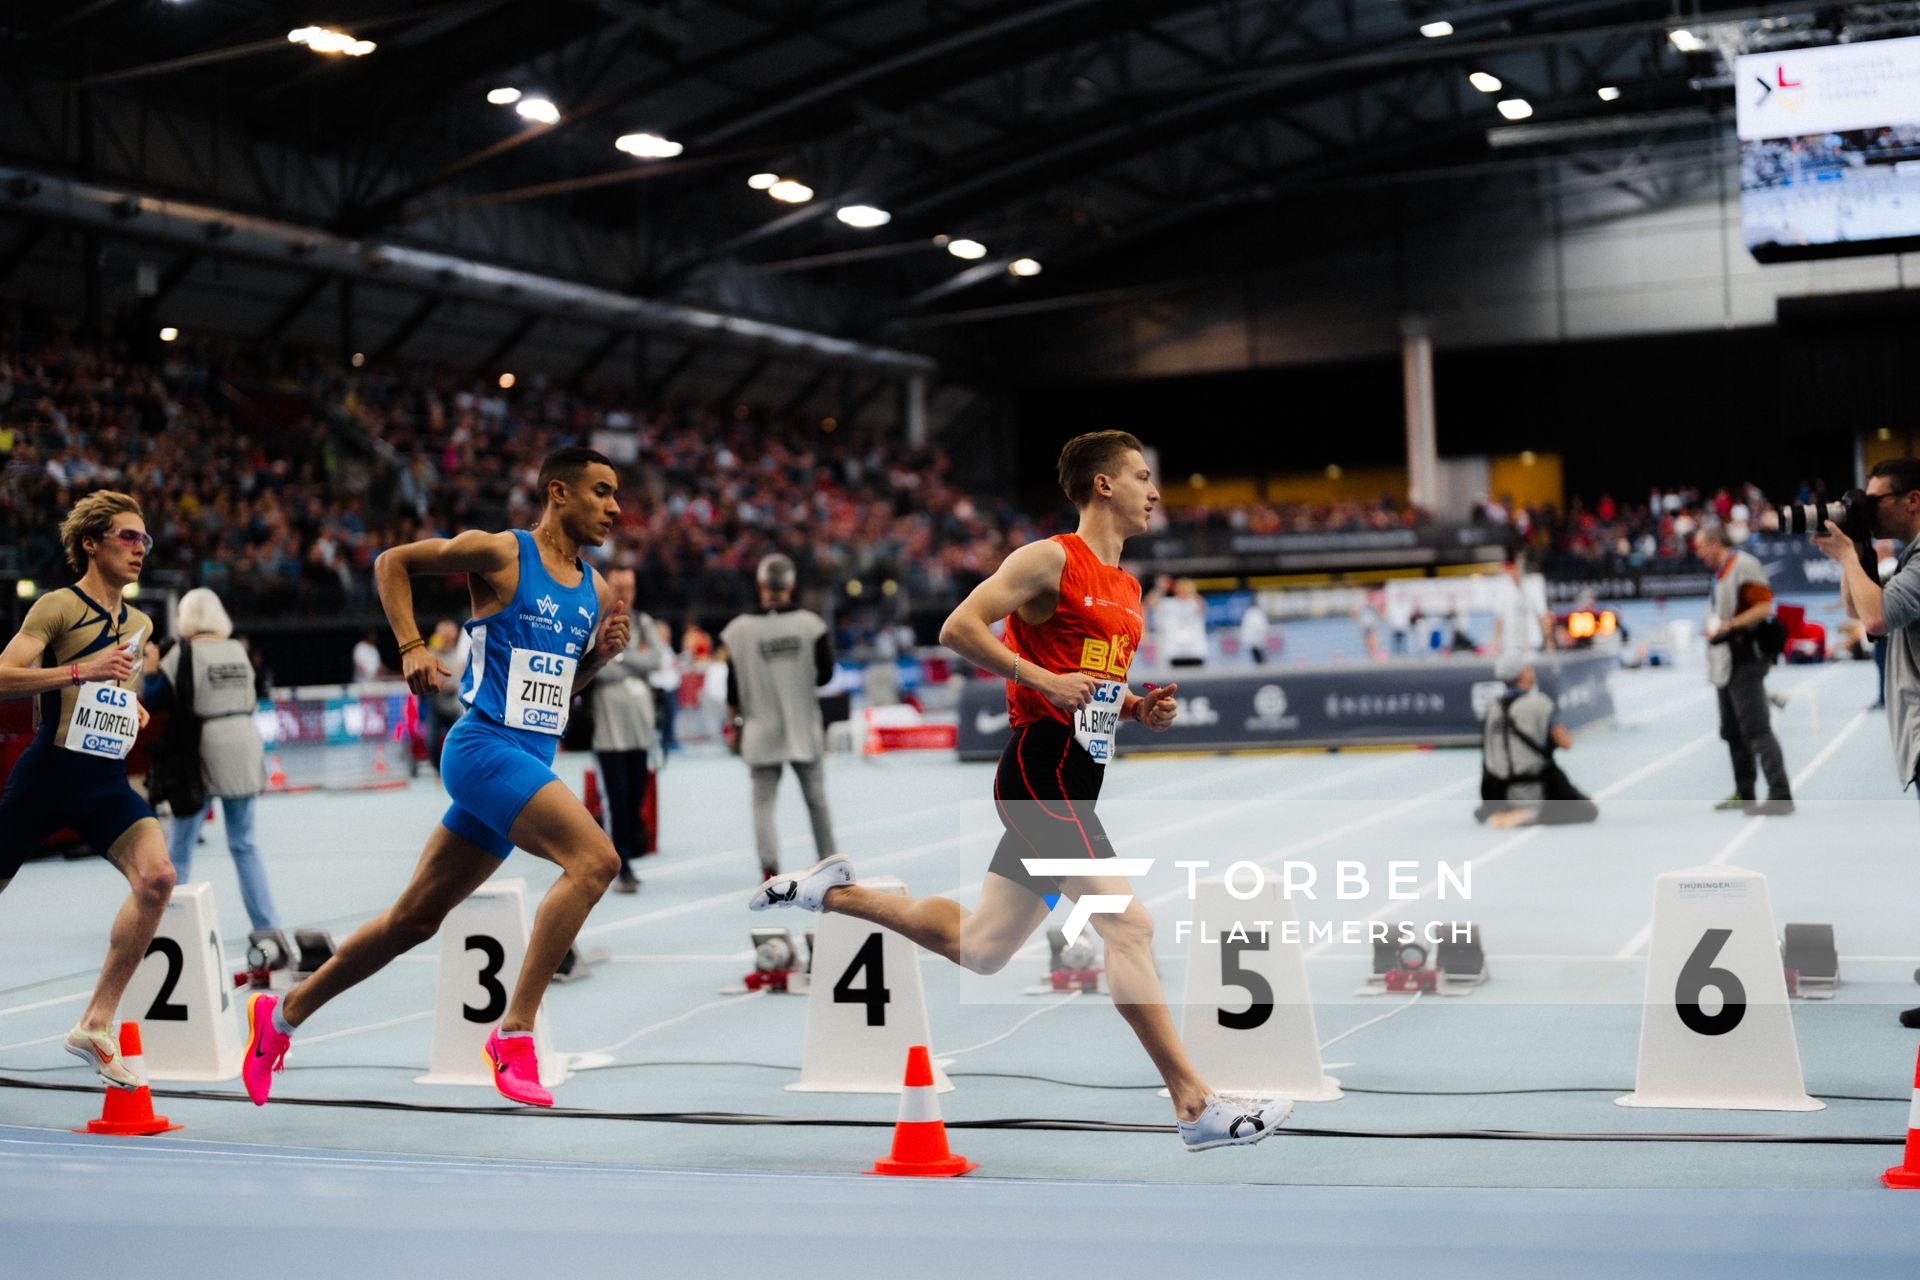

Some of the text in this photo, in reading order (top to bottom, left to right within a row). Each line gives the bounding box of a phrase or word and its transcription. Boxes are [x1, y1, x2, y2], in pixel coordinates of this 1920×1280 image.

[520, 679, 564, 708] ZITTEL
[528, 654, 564, 677] GLS
[95, 687, 128, 708] GLS
[539, 712, 558, 724] PLAN
[99, 738, 122, 750] PLAN
[144, 936, 188, 1021] 2
[463, 934, 508, 1024] 3
[833, 932, 891, 1027] 4
[1217, 931, 1275, 1031] 5
[1675, 928, 1747, 1036] 6
